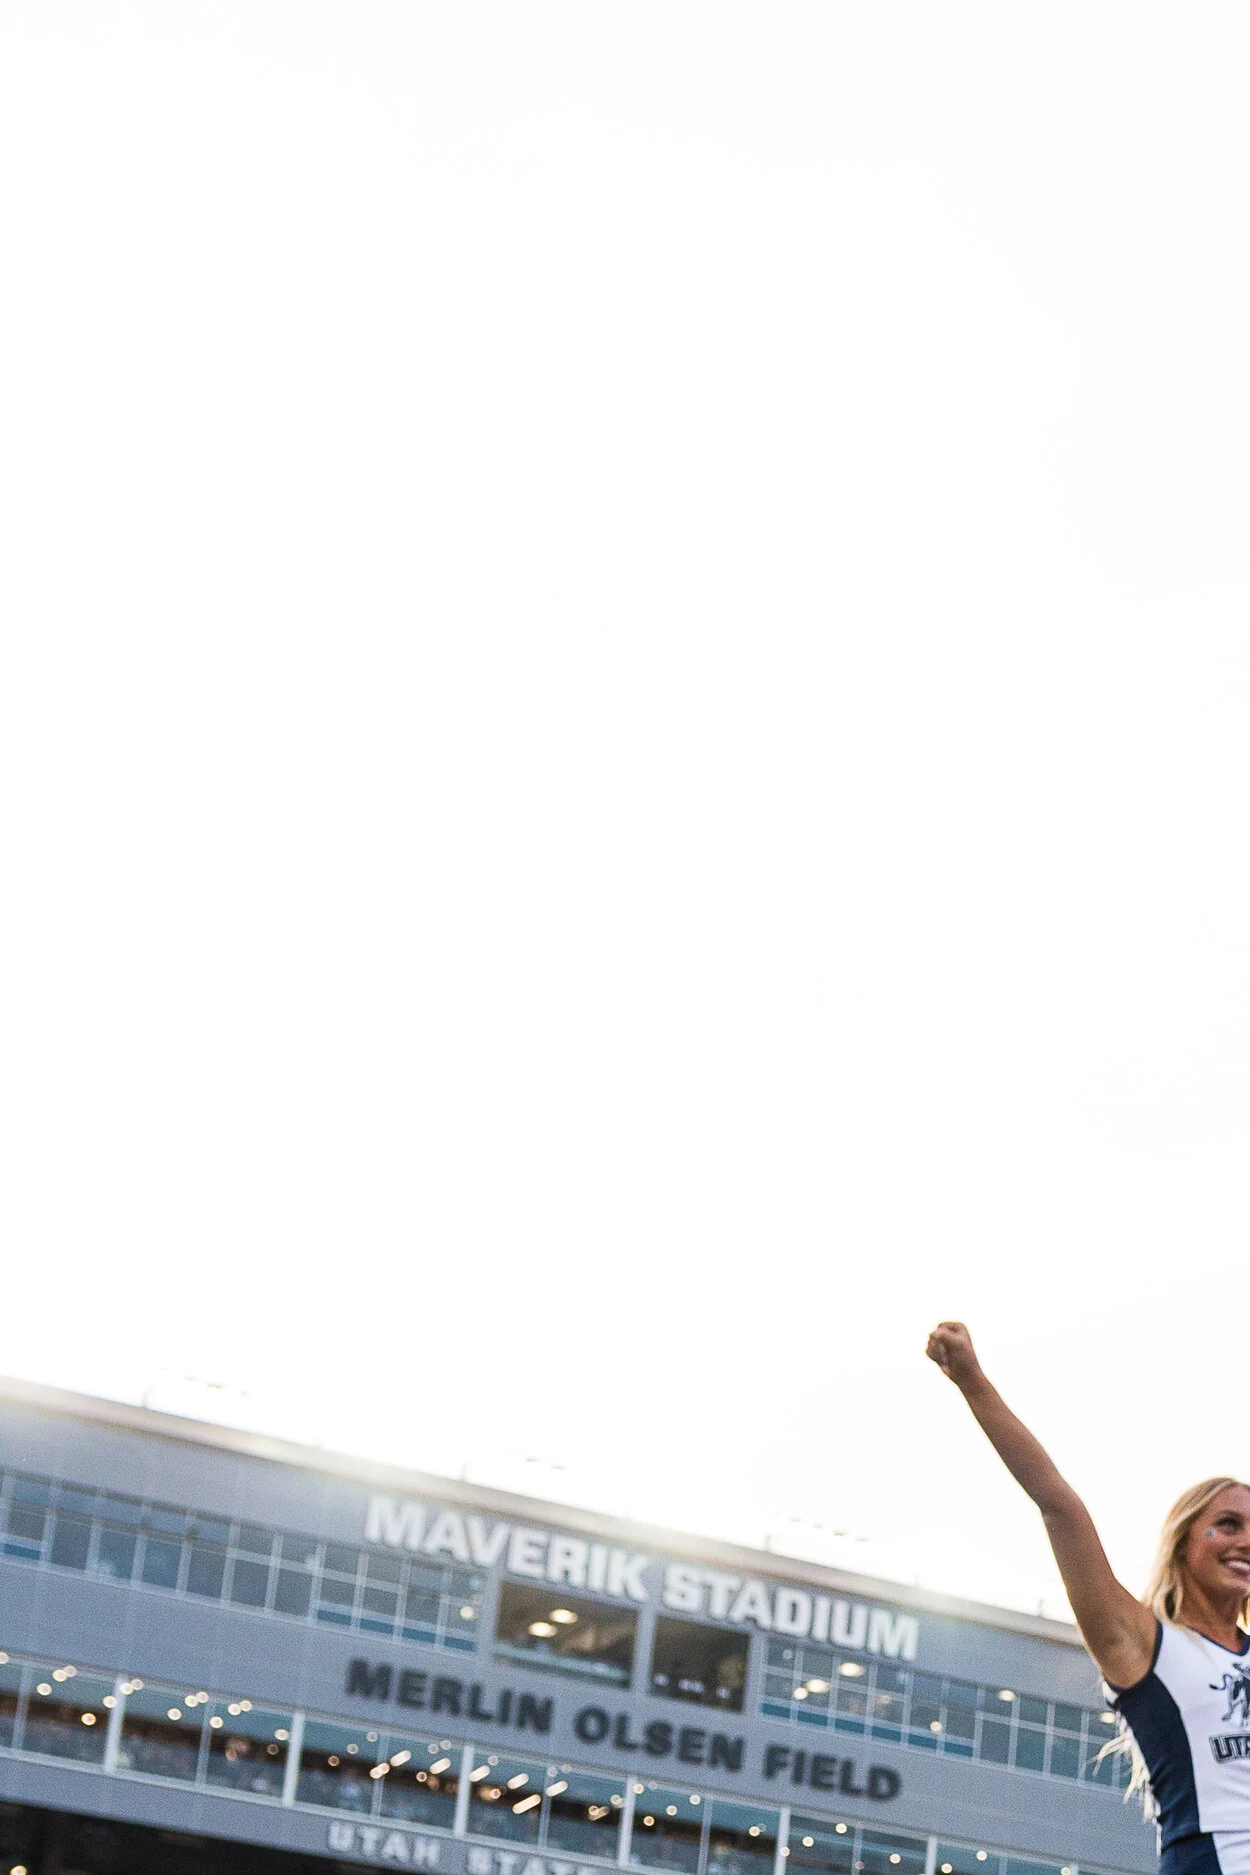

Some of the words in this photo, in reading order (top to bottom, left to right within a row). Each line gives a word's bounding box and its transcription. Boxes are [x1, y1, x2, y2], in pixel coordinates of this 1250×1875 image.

[364, 1496, 651, 1602] MAVERIK
[663, 1561, 919, 1662] STADIUM
[345, 1658, 554, 1734] MERLIN
[573, 1706, 746, 1774] OLSEN
[762, 1744, 903, 1803] FIELD
[328, 1821, 442, 1867] UTAH
